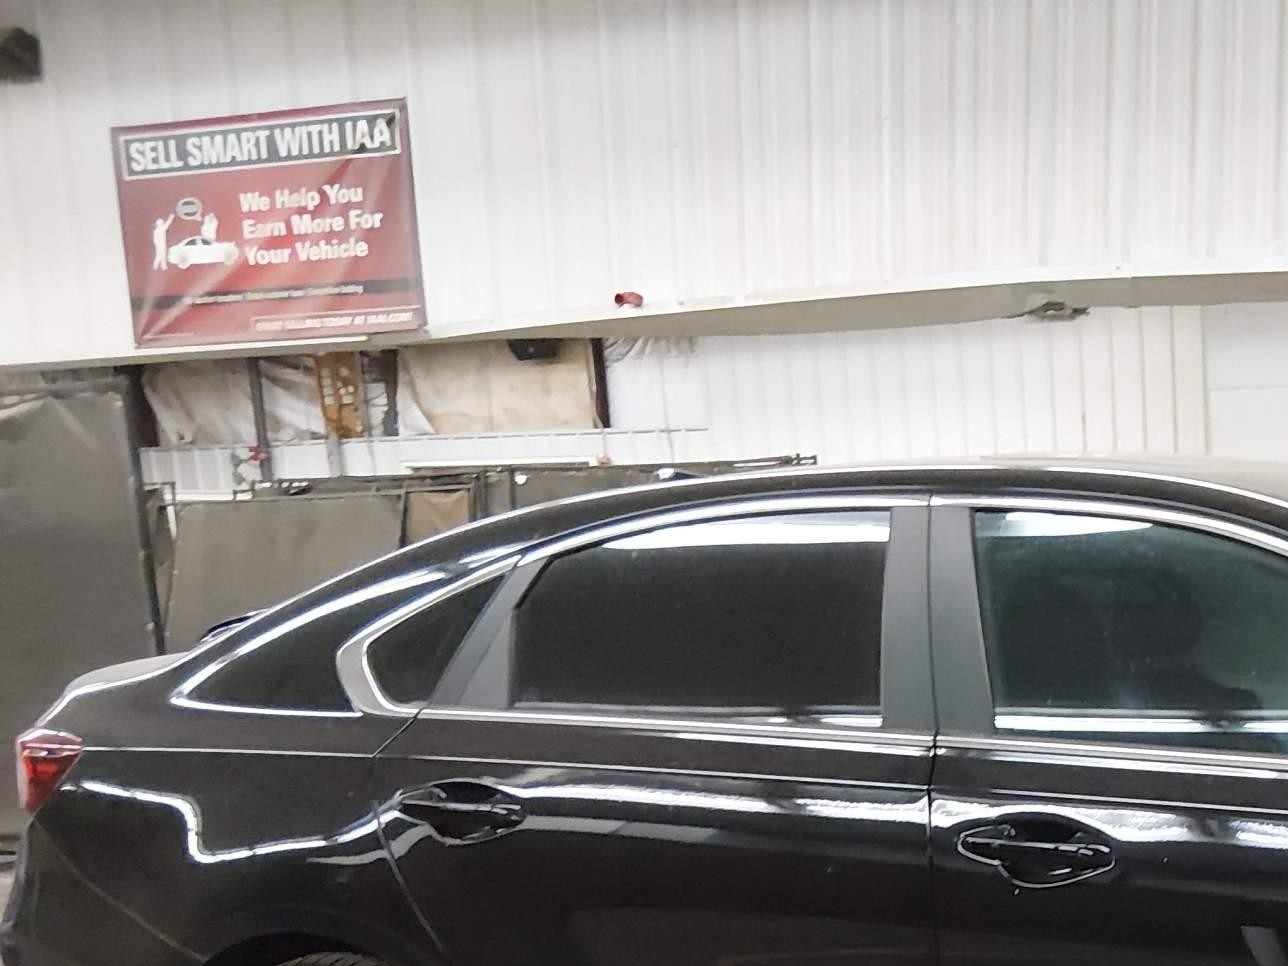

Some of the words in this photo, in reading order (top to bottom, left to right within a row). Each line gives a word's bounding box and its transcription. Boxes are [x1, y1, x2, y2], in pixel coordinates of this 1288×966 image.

[129, 140, 184, 172] SELL
[186, 130, 271, 167] SMART
[273, 121, 340, 158] WITH
[345, 117, 393, 152] IAA
[239, 191, 271, 212] We
[274, 187, 321, 210] Help
[322, 183, 364, 205] You
[242, 218, 287, 240] Earn
[290, 213, 345, 236] More
[348, 208, 384, 230] For
[244, 245, 292, 266] Your
[294, 237, 369, 262] Vehicle
